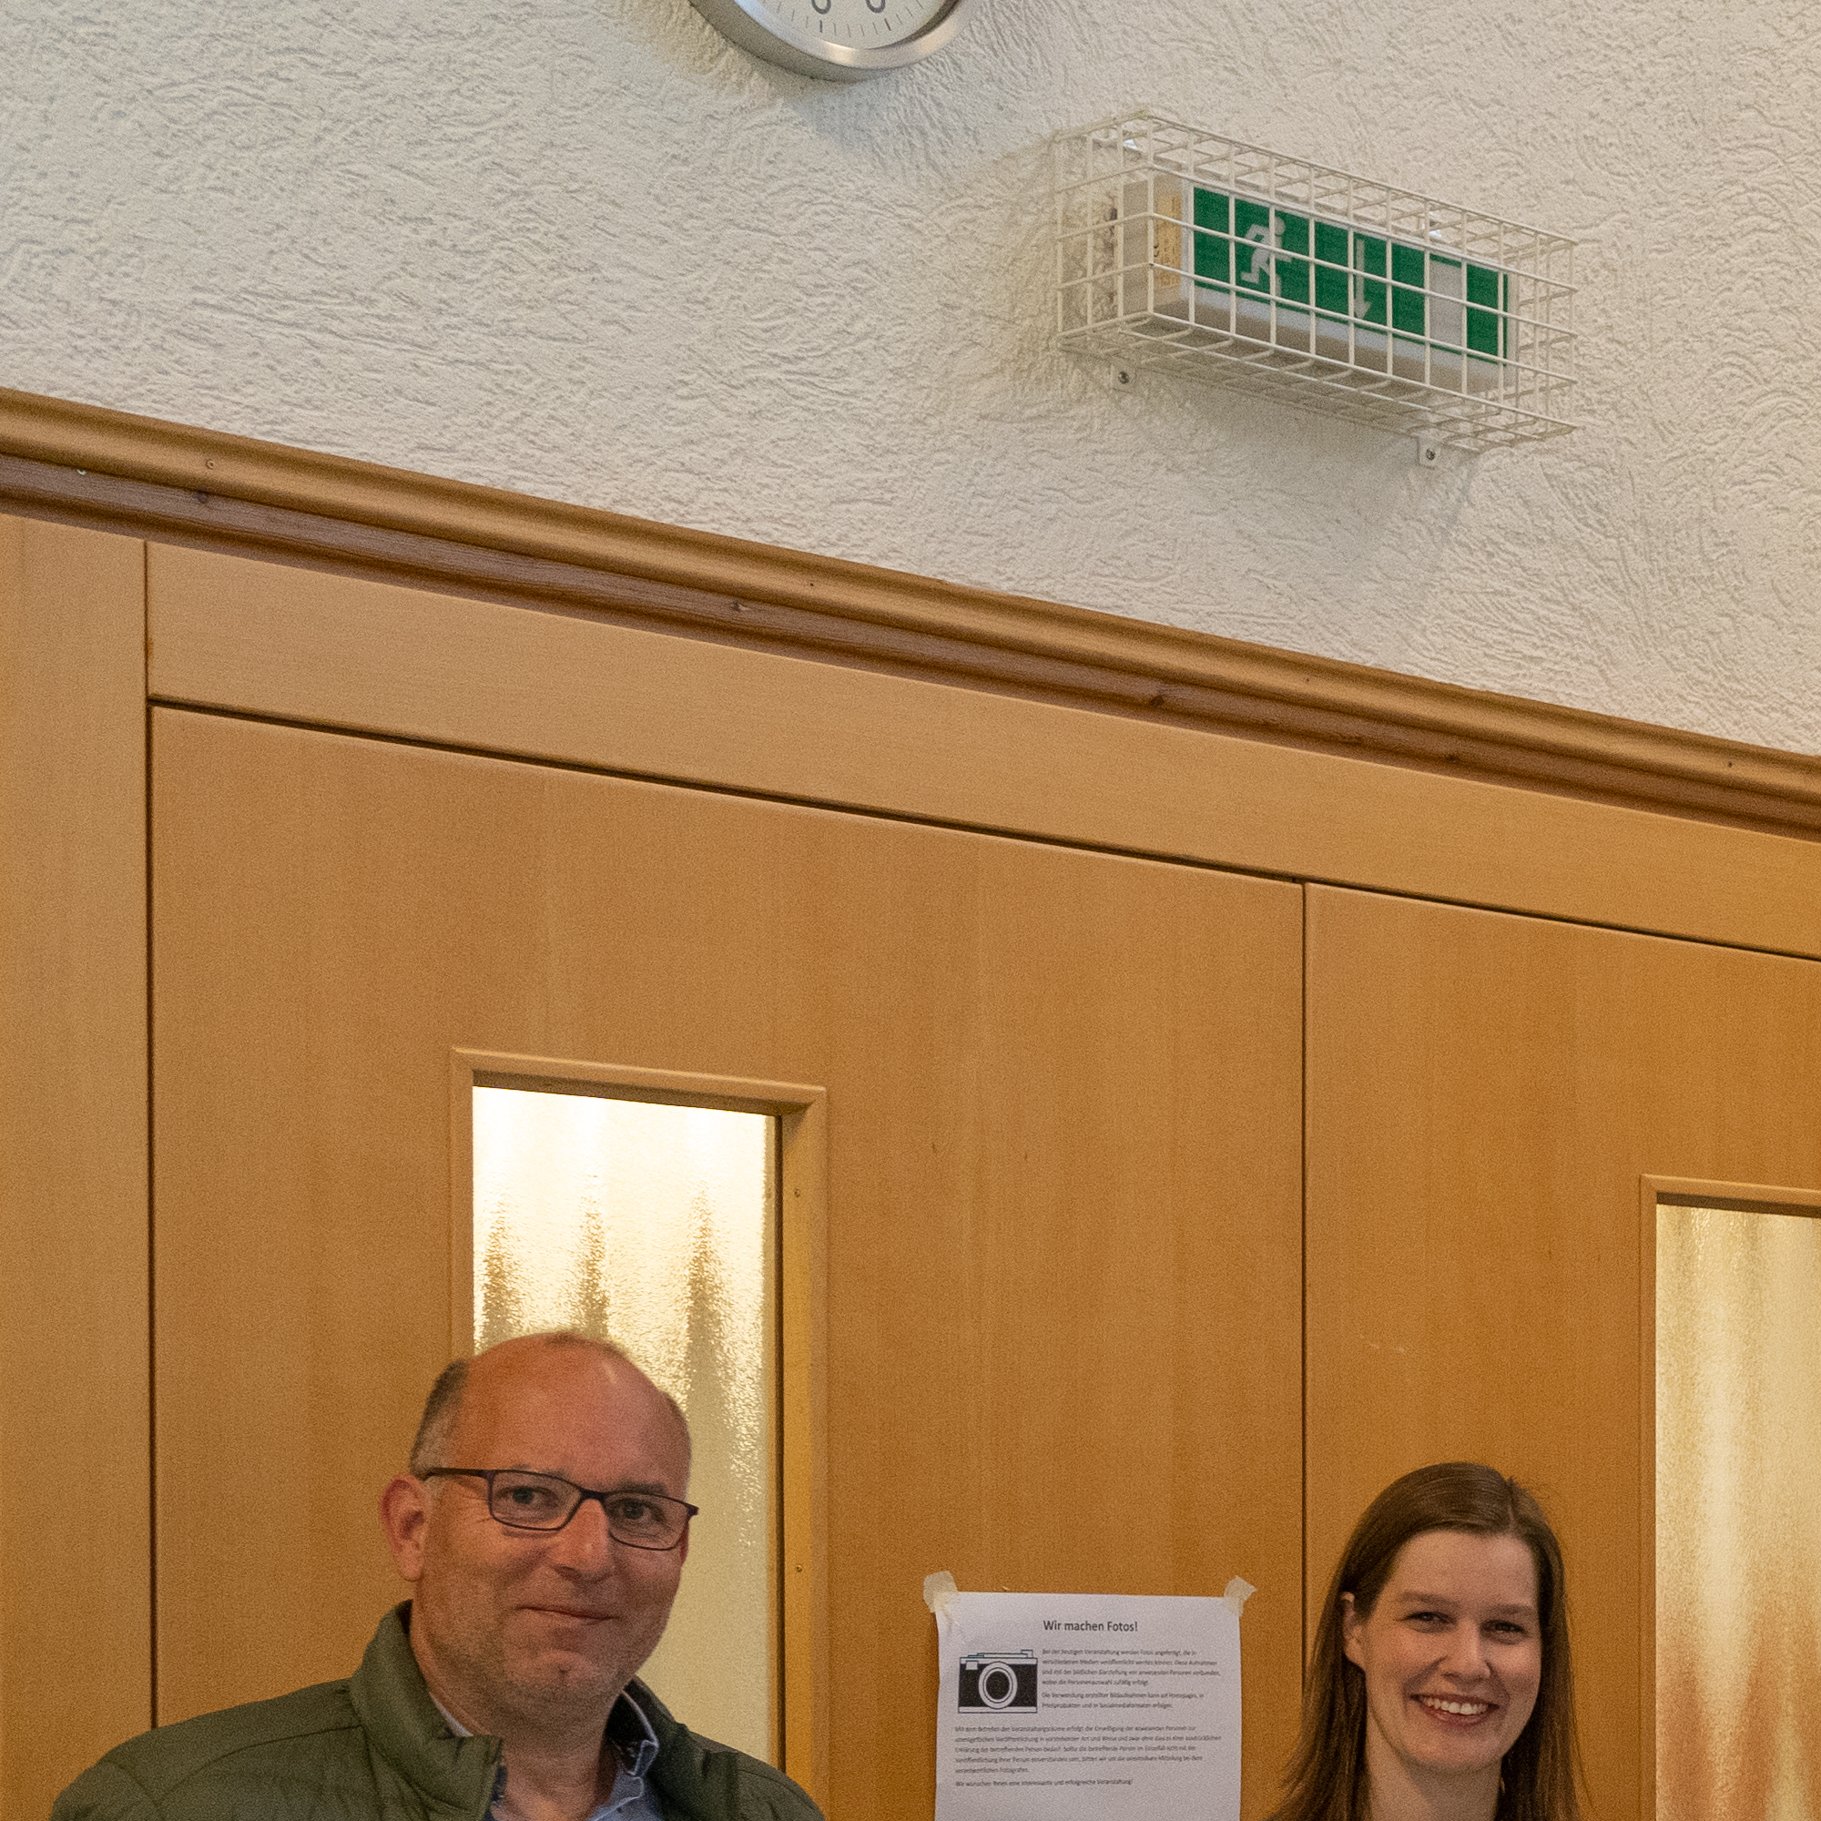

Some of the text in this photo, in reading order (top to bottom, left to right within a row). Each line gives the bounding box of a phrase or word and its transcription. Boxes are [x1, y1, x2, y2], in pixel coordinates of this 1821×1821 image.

[1043, 1620, 1138, 1632] Wir machen Fotos!
